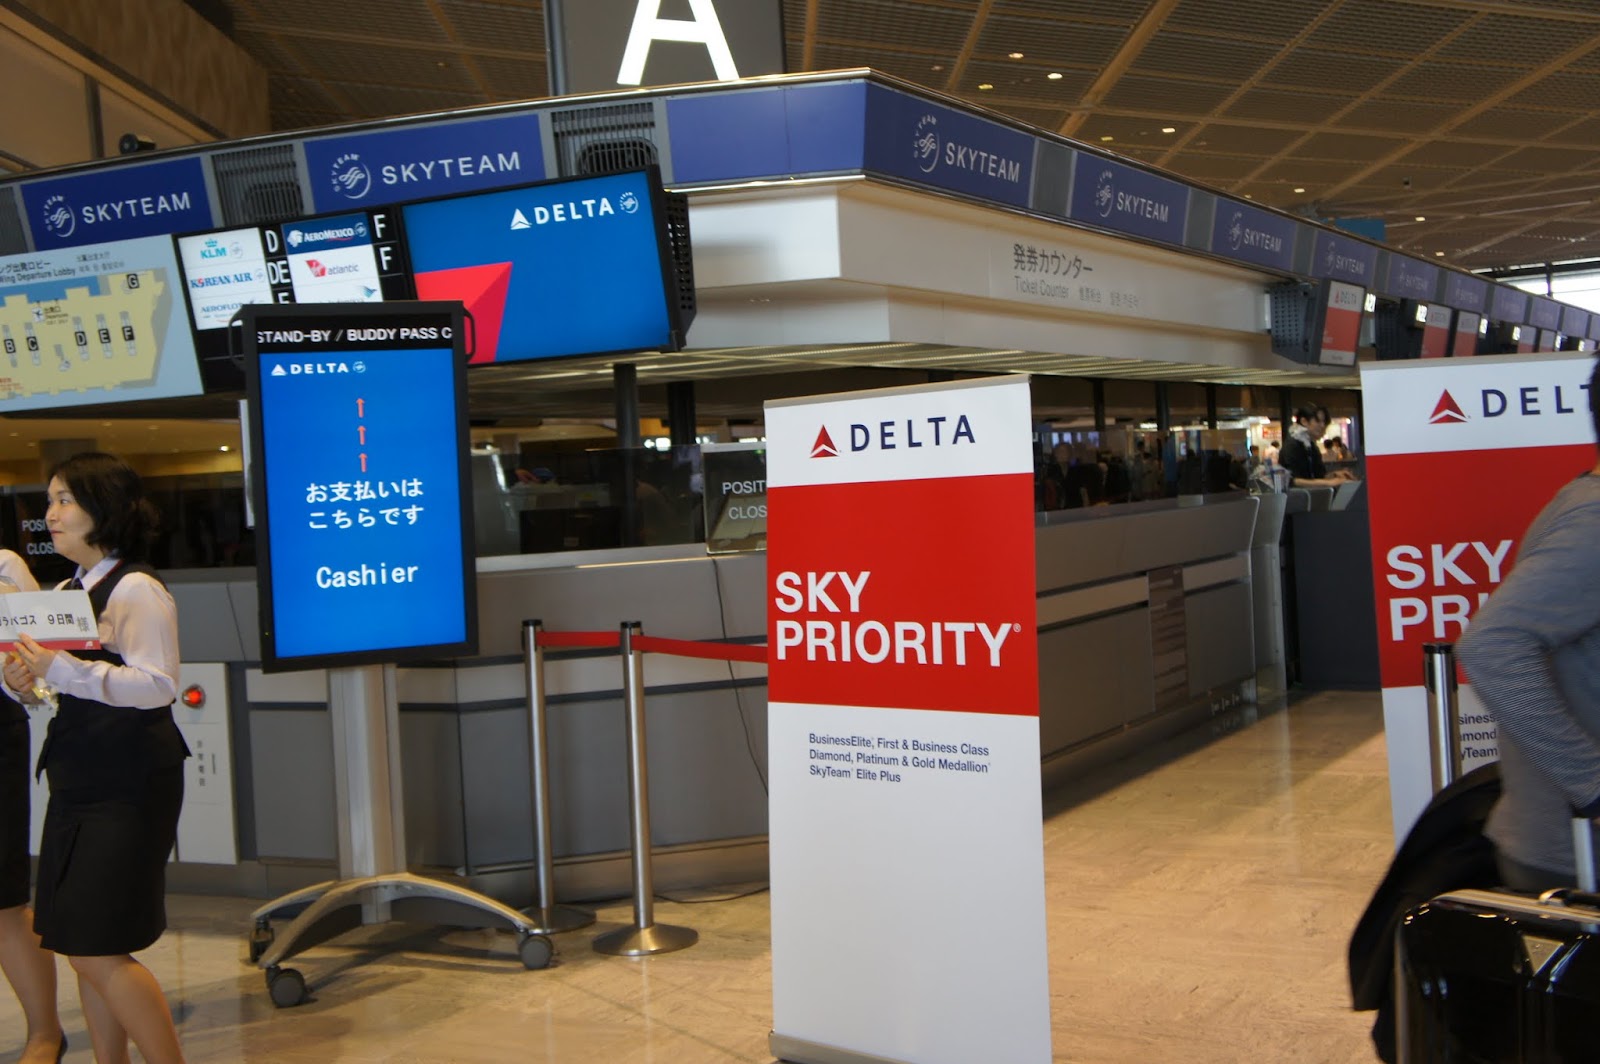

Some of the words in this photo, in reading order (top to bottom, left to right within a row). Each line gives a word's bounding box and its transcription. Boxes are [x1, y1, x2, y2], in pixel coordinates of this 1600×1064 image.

[617, 0, 740, 85] A
[382, 151, 521, 184] SKYTEAM
[945, 142, 1020, 183] SKYTEAM
[82, 192, 191, 224] SKYTEAM
[534, 197, 615, 225] DELTA
[1117, 192, 1169, 223] SKYTEAM
[373, 214, 386, 238] F
[200, 247, 227, 260] KLM
[265, 229, 279, 253] D
[1244, 228, 1282, 252] SKYTEAM
[327, 262, 359, 276] atlantic
[379, 246, 392, 271] F
[1013, 243, 1093, 279] 発券カウンター
[17, 270, 52, 281] Departure
[54, 266, 76, 278] Lobby
[128, 274, 139, 288] G
[190, 275, 231, 289] KOREAN
[231, 271, 253, 284] AIR
[267, 260, 291, 285] DE
[28, 336, 38, 350] C
[76, 331, 87, 346] D
[99, 329, 110, 343] E
[123, 326, 134, 341] F
[257, 329, 331, 343] STAND-BY
[347, 328, 397, 342] BUDDY
[400, 327, 437, 340] PASS
[5, 339, 15, 353] B
[290, 362, 349, 375] DELTA
[850, 414, 976, 452] DELTA
[305, 478, 424, 504] お支払いは
[722, 480, 765, 495] POSIT
[308, 504, 424, 529] こちらです
[729, 505, 767, 520] CLOS
[316, 562, 419, 589] Cashier
[1386, 539, 1513, 590] SKY
[775, 571, 871, 613] SKY
[47, 613, 75, 626] 9日間
[877, 737, 899, 750] First
[901, 739, 910, 750] &
[912, 739, 957, 754] Business
[960, 743, 989, 756] Class
[1460, 728, 1497, 742] mond
[809, 749, 854, 764] Diamond,
[856, 752, 899, 766] Platinum
[901, 756, 910, 767] &
[912, 756, 936, 769] Gold
[938, 758, 989, 773] Medallion
[809, 764, 852, 779] SkyTeam
[856, 768, 877, 781] Elite
[880, 770, 901, 783] Plus
